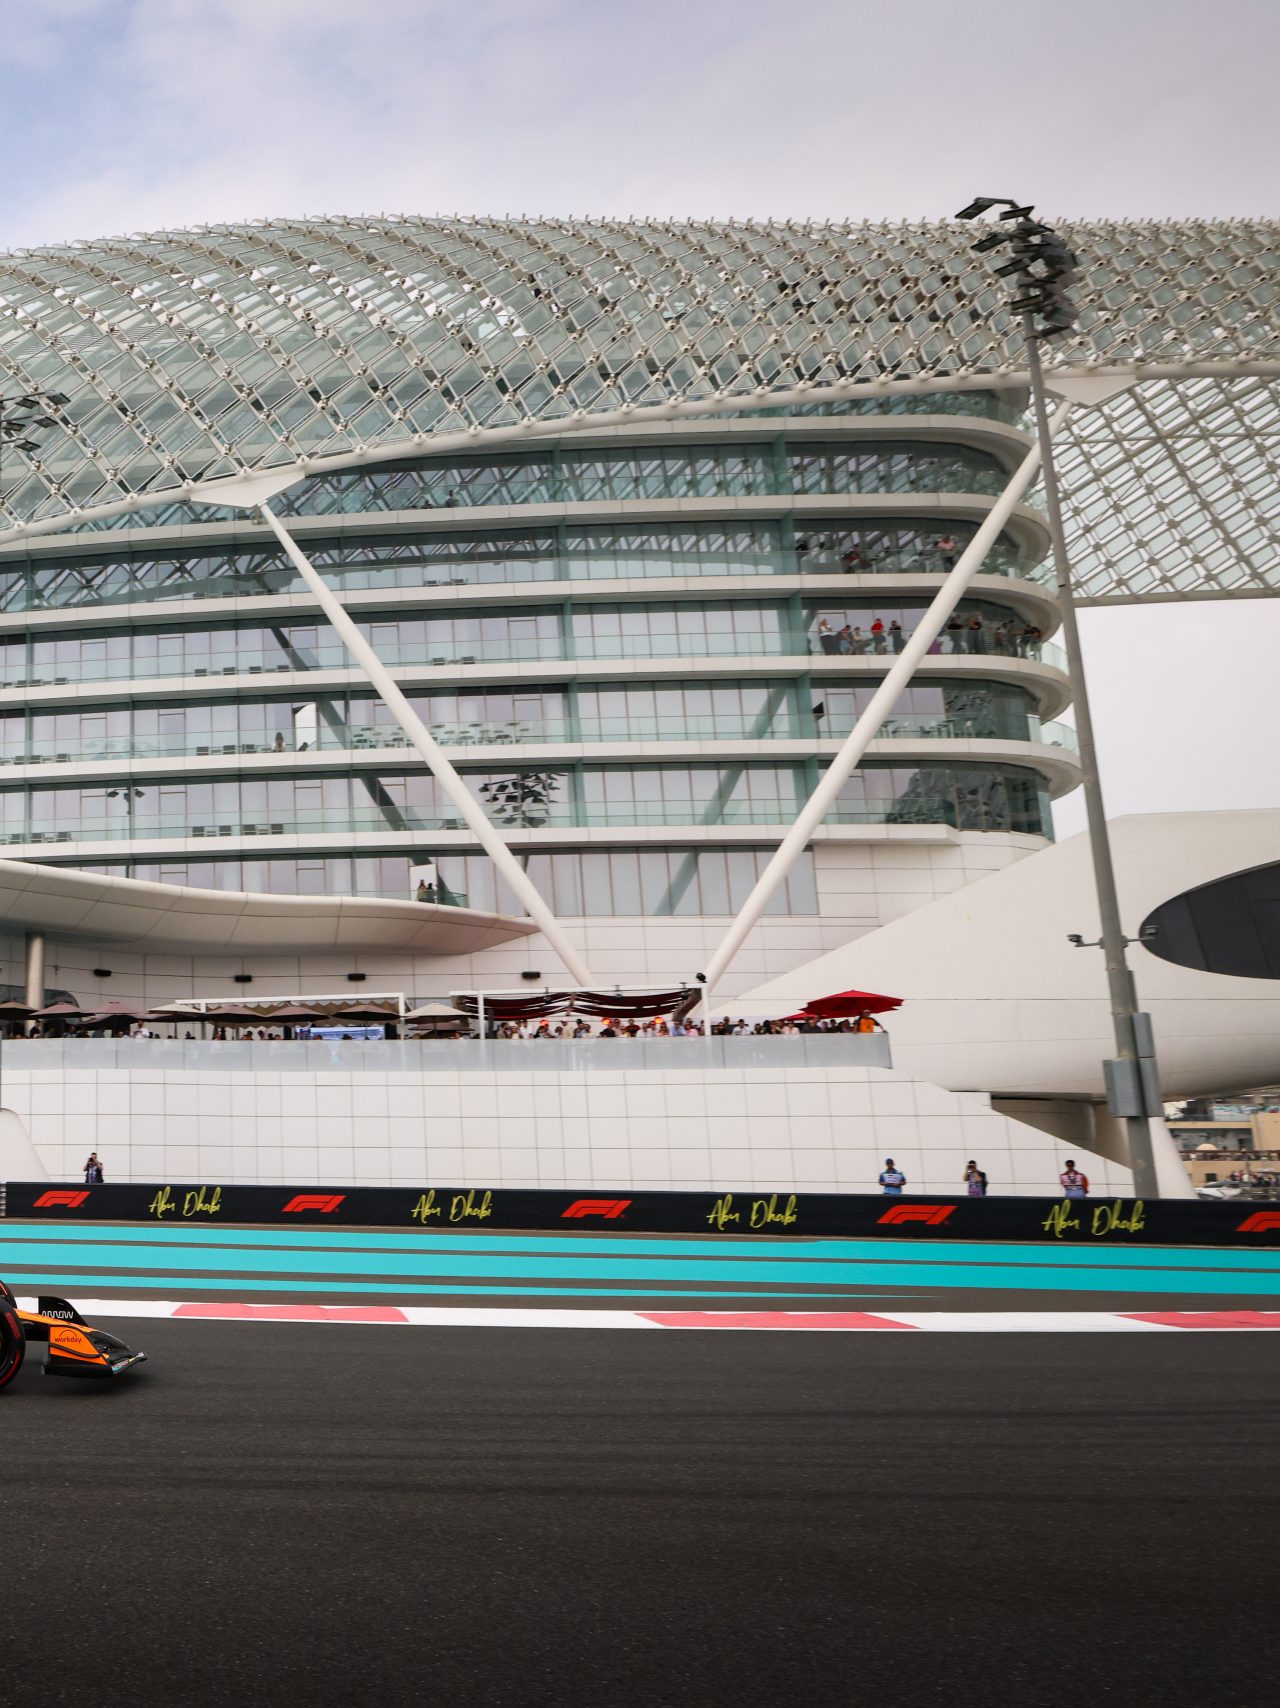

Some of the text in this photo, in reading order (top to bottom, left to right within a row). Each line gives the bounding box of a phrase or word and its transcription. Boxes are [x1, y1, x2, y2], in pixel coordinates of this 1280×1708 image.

[32, 1190, 91, 1207] F1
[149, 1185, 222, 1218] Abu Dhabi
[281, 1194, 347, 1212] F1
[411, 1189, 492, 1224] Abu Dhabi
[559, 1199, 632, 1218] F1
[706, 1194, 798, 1231] Abu Dhabi
[875, 1204, 958, 1224] F1
[1041, 1199, 1145, 1238] Abu Dhabi
[54, 1336, 82, 1344] workday
